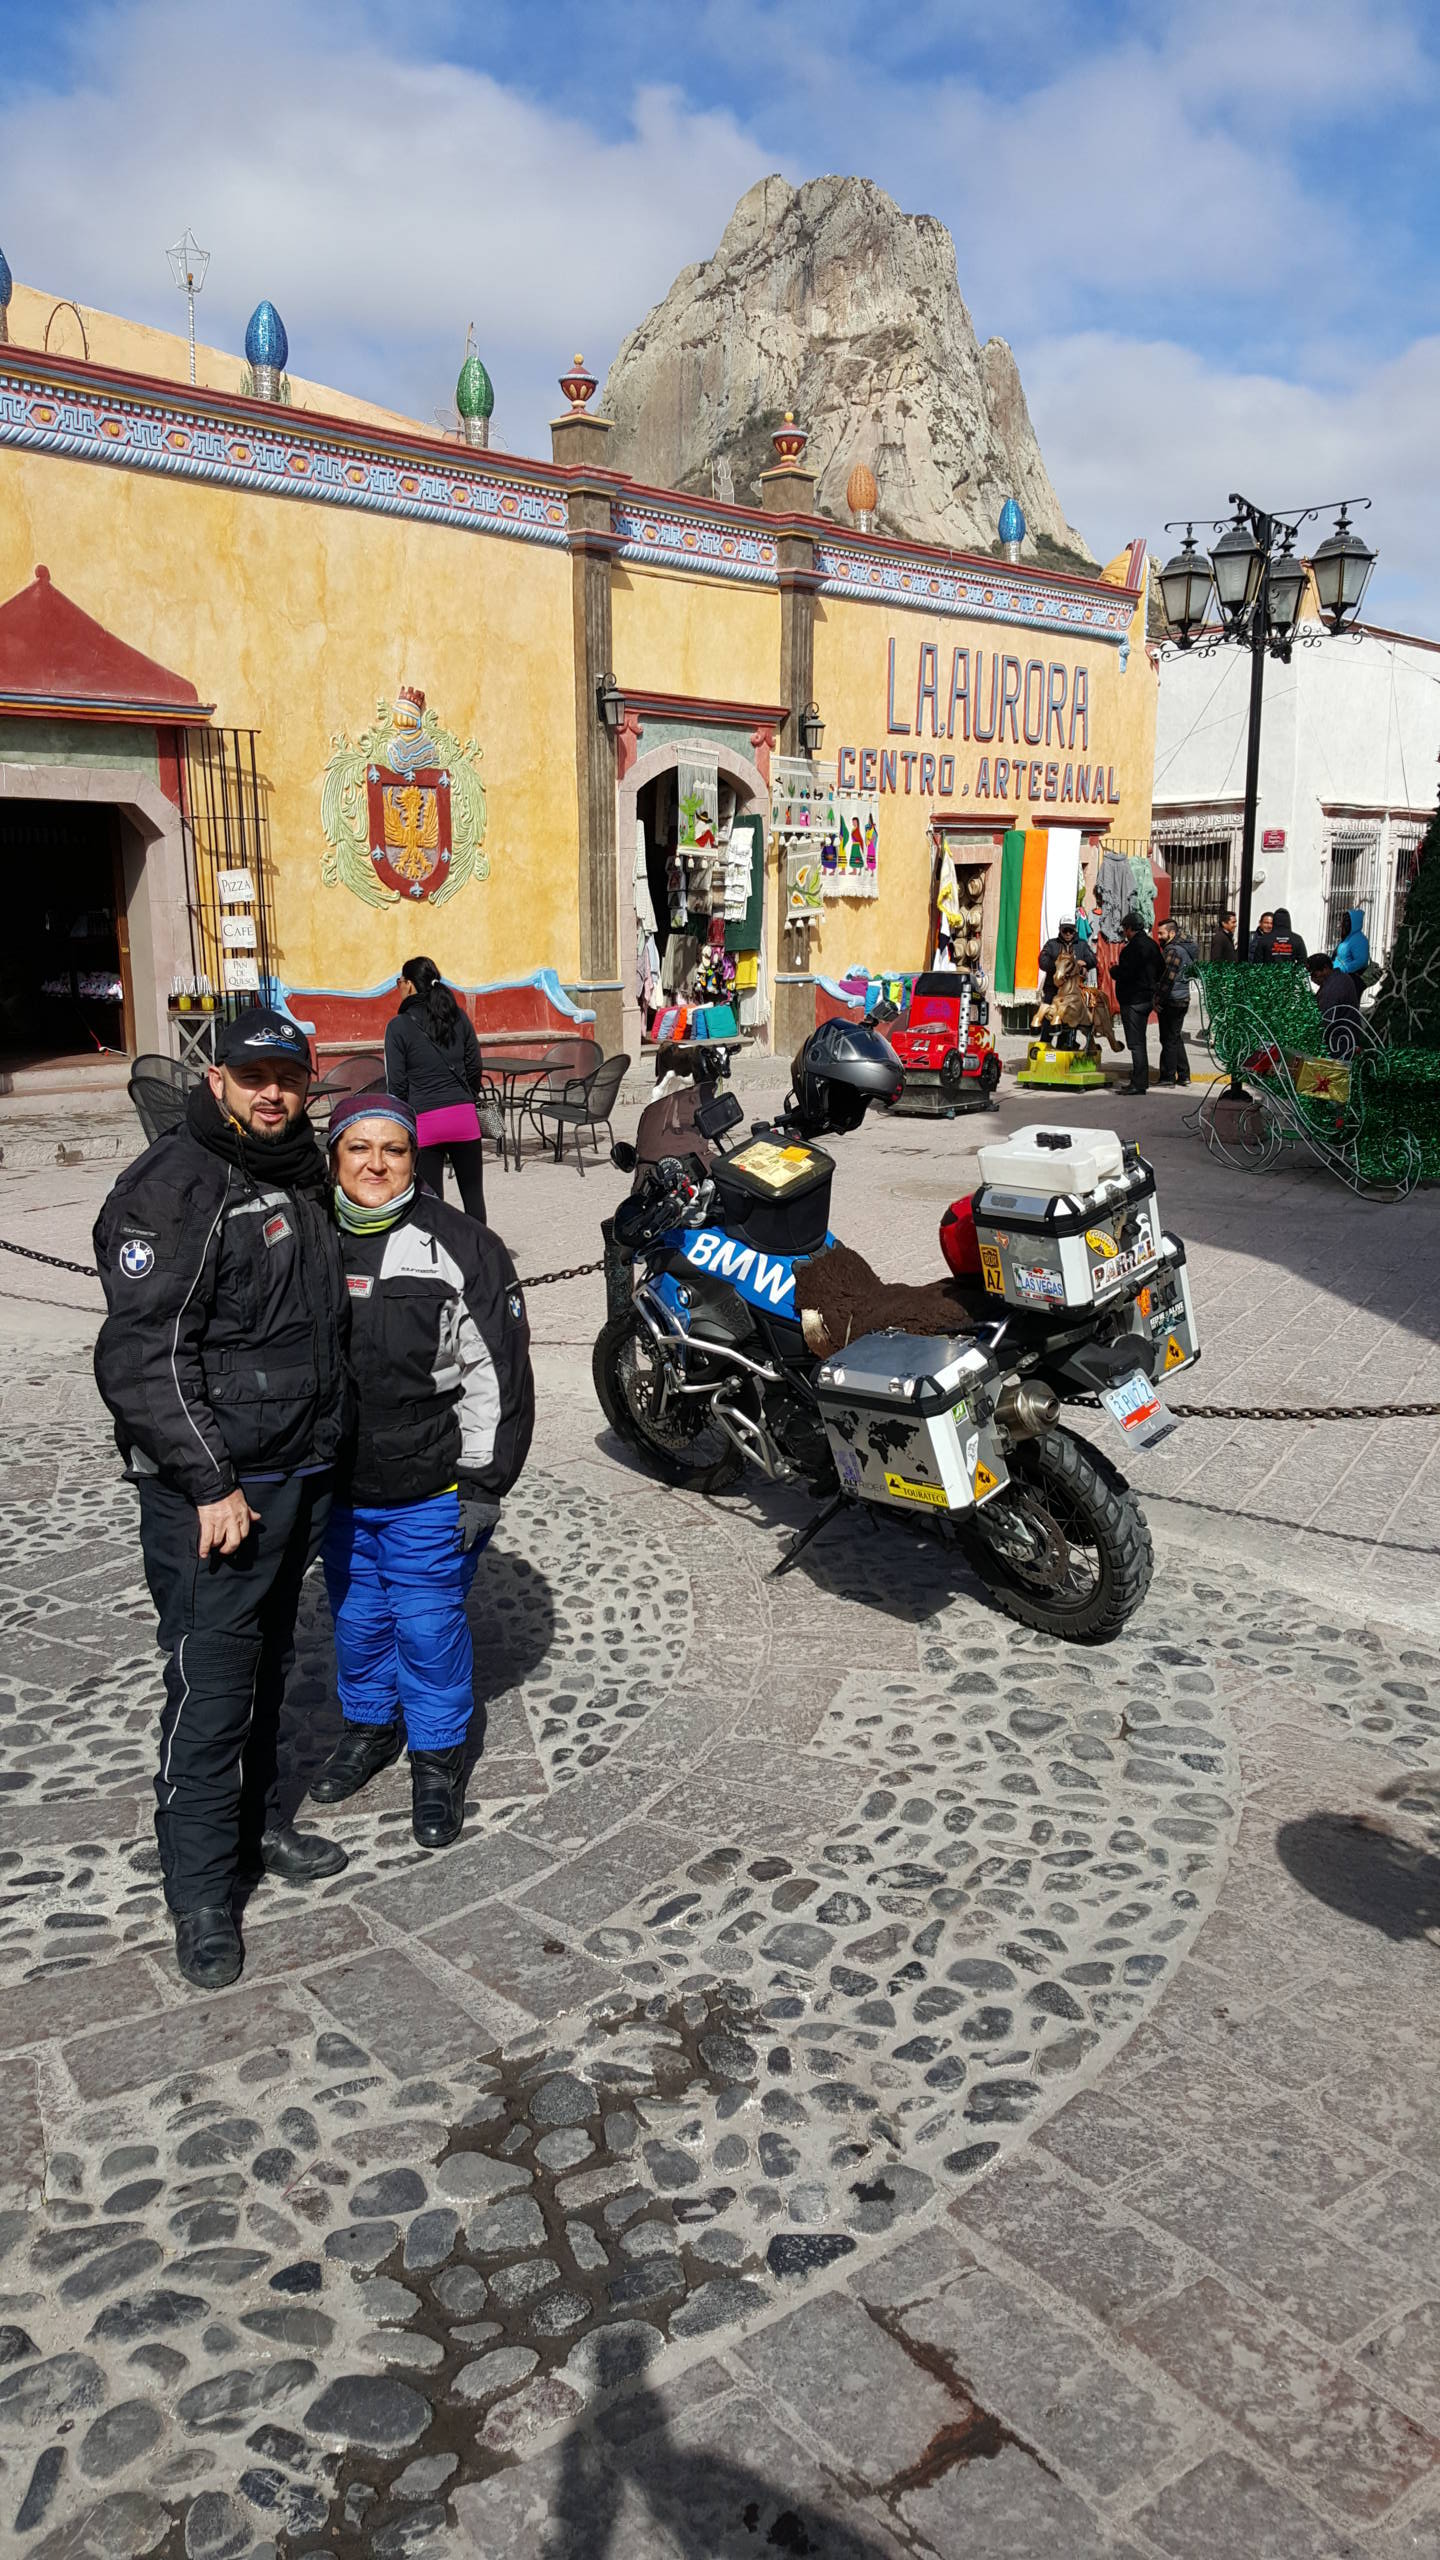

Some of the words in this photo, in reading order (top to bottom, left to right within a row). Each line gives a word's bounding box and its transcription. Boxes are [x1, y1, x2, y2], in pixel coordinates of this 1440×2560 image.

[947, 646, 1089, 751] AURORA
[975, 757, 1121, 805] ARTESANAL
[687, 1232, 797, 1305] BMW
[987, 1268, 1003, 1291] AZ
[1020, 1276, 1035, 1291] LAS
[1036, 1279, 1063, 1296] VEGAS
[1094, 1239, 1156, 1290] PARRAL
[903, 1487, 948, 1504] TOURATECH
